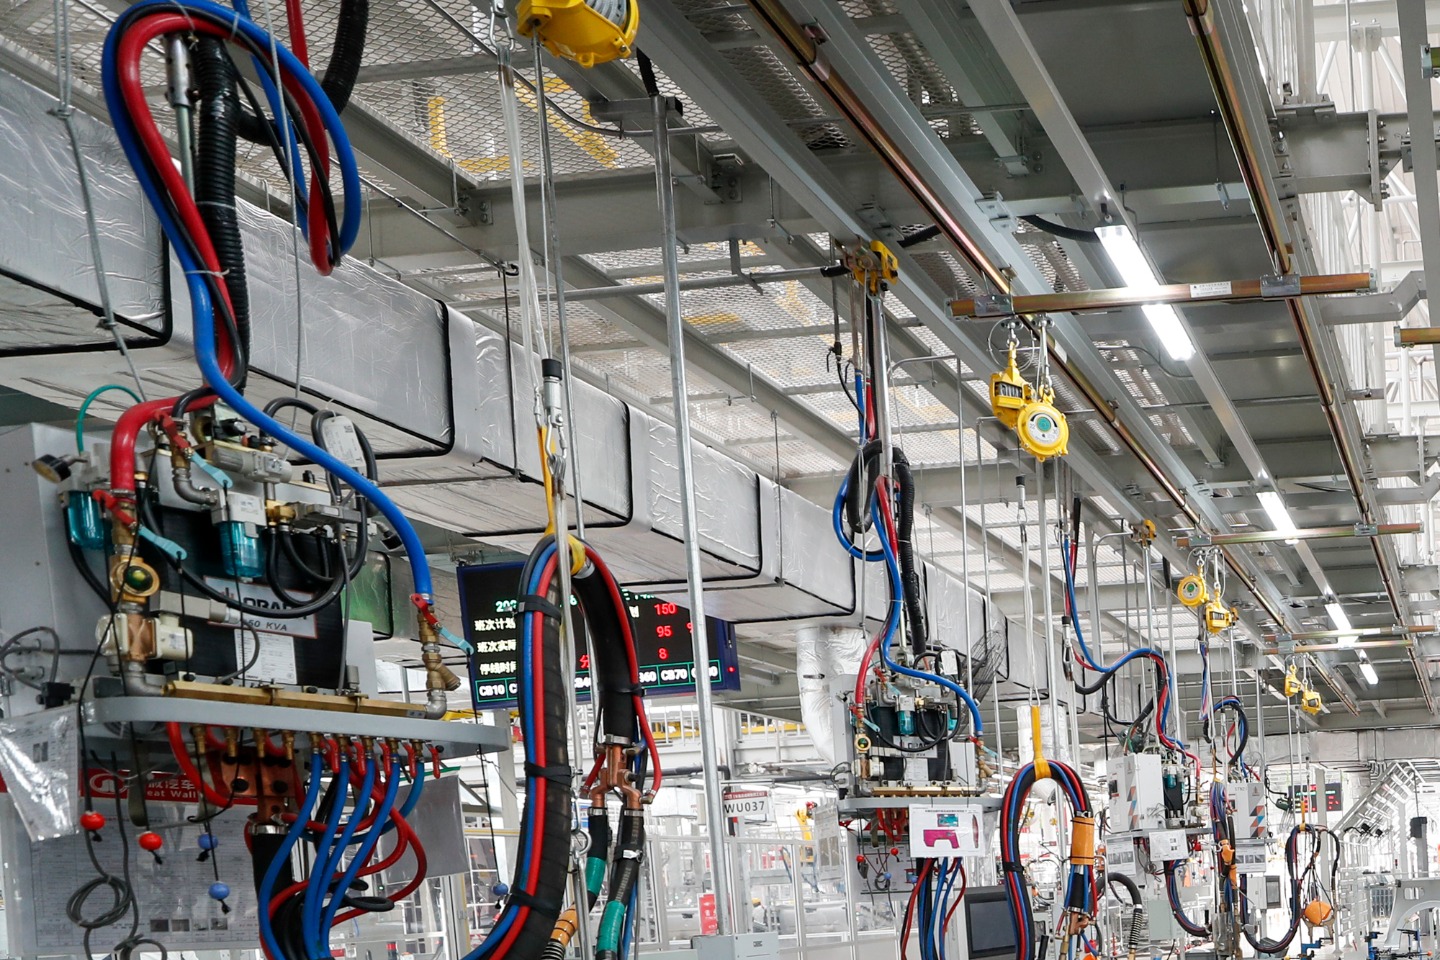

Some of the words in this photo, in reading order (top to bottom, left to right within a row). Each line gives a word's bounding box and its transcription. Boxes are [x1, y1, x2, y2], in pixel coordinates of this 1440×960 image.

[654, 602, 677, 615] 150
[266, 621, 288, 631] KVA
[656, 625, 673, 637] 95
[658, 647, 667, 660] 8
[478, 684, 506, 696] CB10
[660, 668, 688, 681] CB70
[724, 801, 765, 813] WU037
